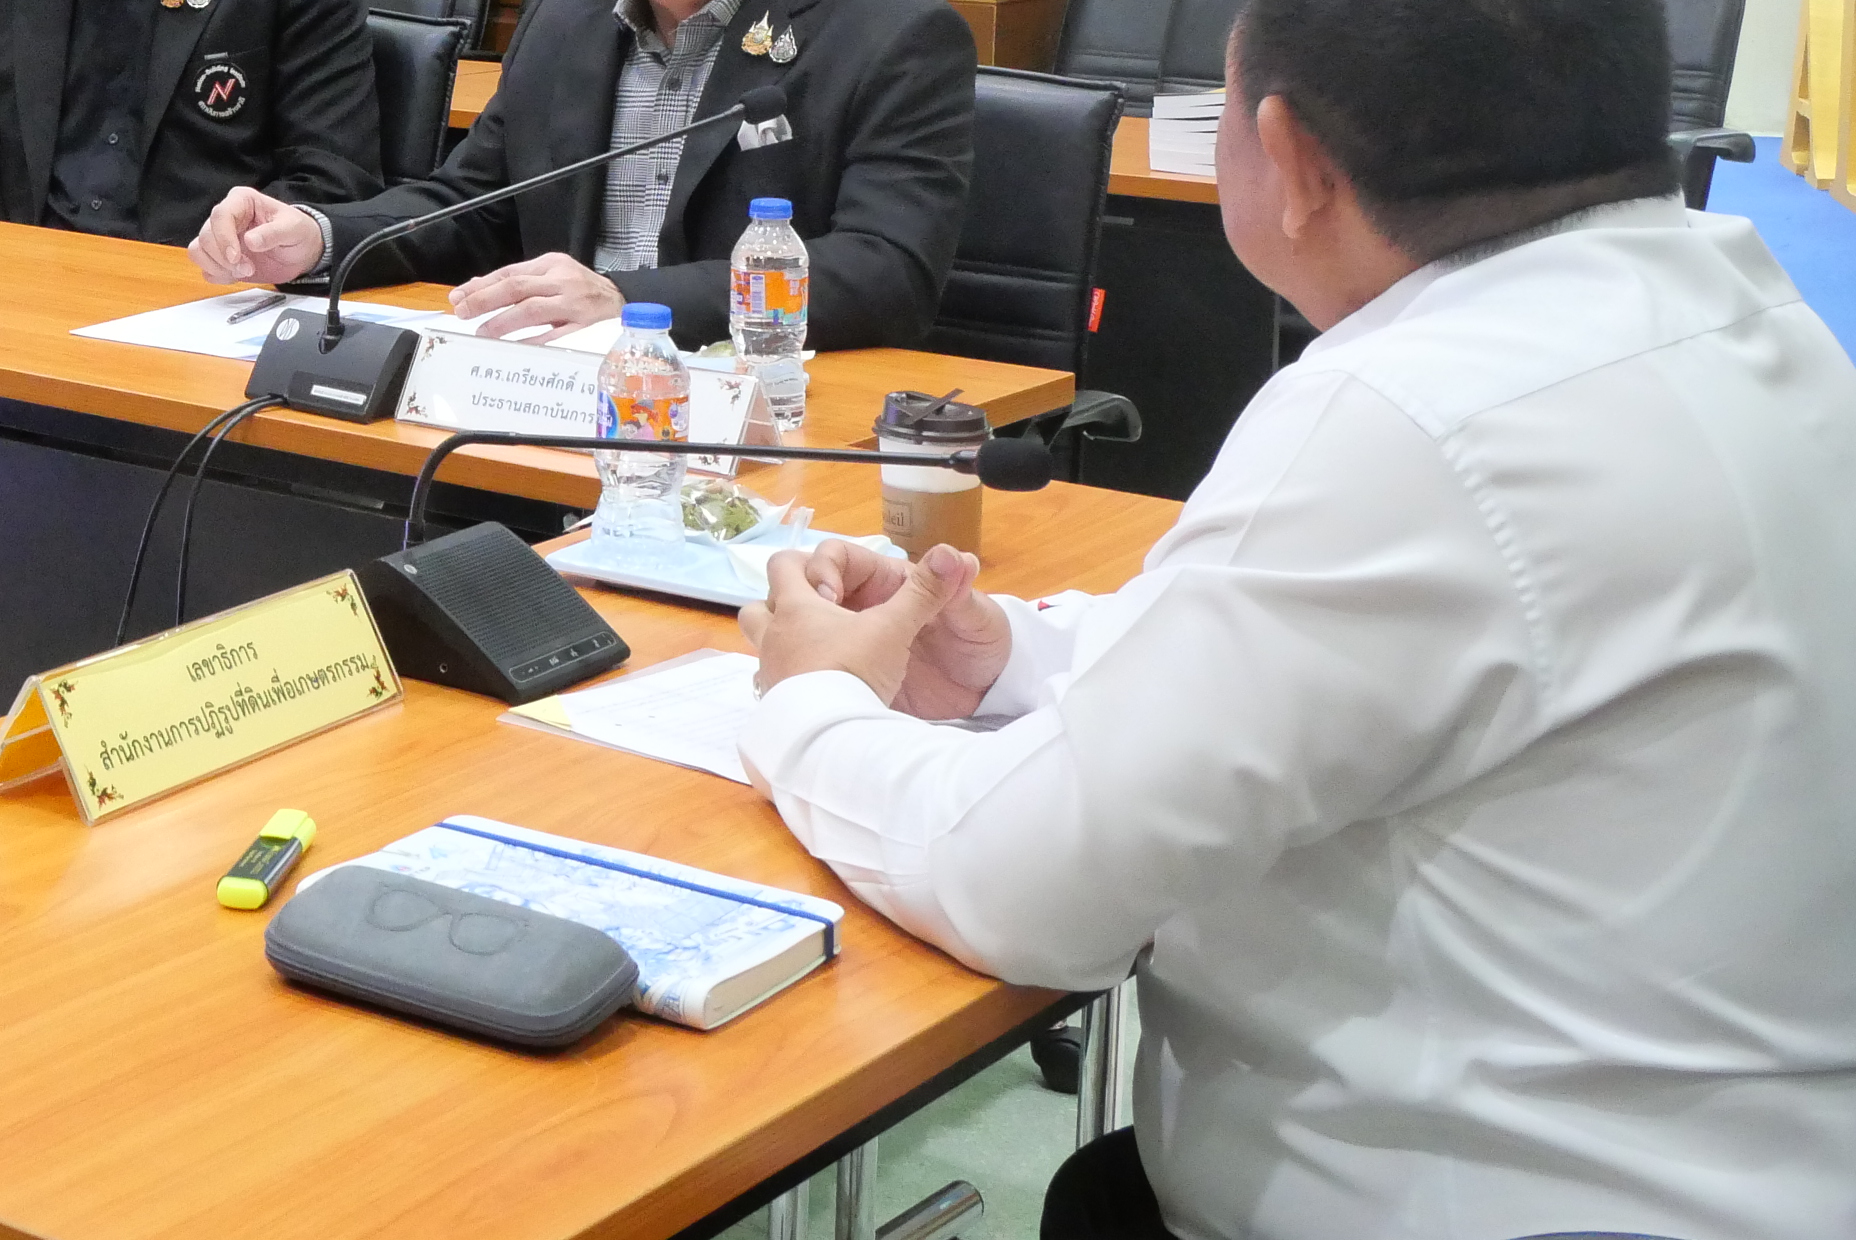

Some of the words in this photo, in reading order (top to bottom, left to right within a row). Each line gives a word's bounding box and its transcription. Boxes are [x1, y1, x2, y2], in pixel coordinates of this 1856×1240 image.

[470, 365, 579, 392] ศ.ดร.เกรียงศักดิ์
[186, 640, 259, 682] เลขาธิการ
[99, 652, 369, 770] สำนักงานการปฏิรูปที่ดินเพื่อเกษตรกรรม
